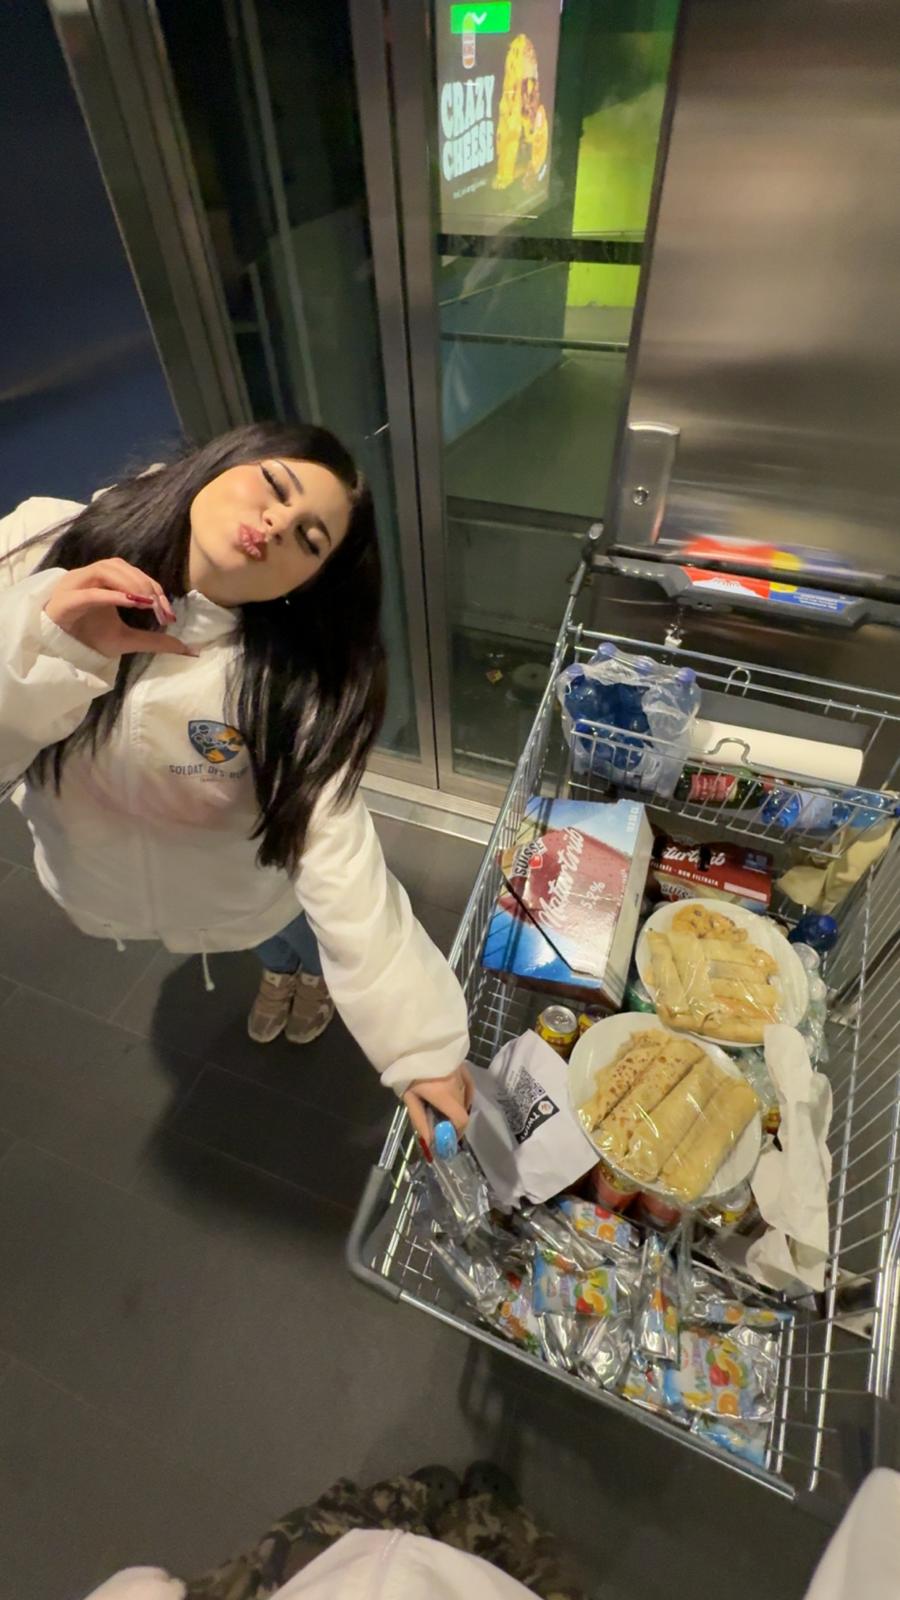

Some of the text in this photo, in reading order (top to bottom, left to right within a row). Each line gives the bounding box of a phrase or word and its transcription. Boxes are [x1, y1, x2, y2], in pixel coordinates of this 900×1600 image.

[440, 74, 495, 139] CRAZY
[443, 120, 494, 181] CHEESE
[169, 764, 203, 775] SOLDAT
[514, 839, 545, 876] SUISSE
